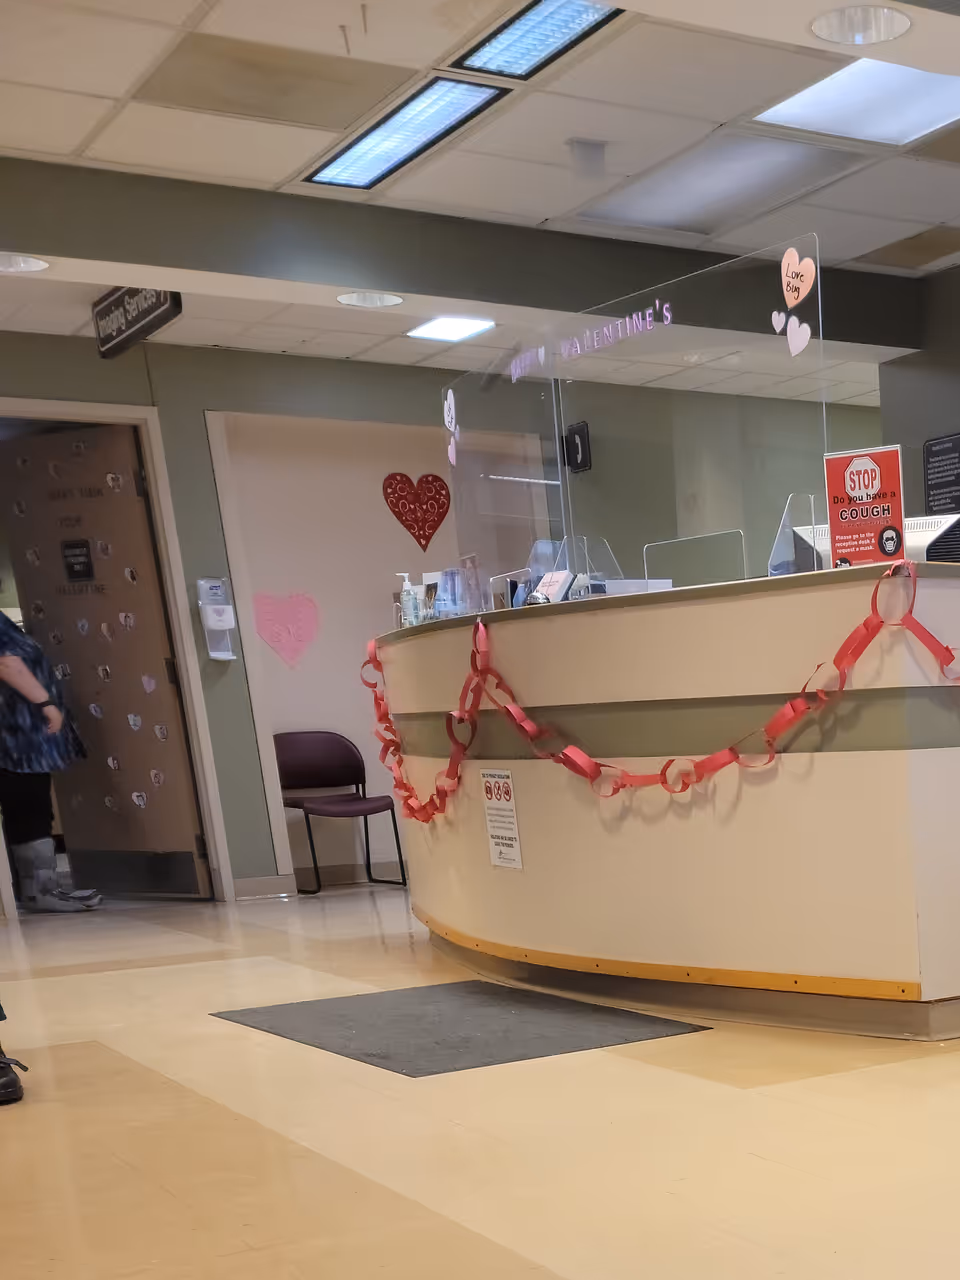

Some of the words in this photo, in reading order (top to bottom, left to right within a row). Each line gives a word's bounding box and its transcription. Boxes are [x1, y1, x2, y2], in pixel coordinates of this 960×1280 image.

[785, 263, 805, 283] Love
[785, 281, 800, 300] Bug
[848, 468, 877, 492] STOP
[833, 495, 845, 505] Do
[847, 495, 864, 505] you
[866, 491, 888, 501] have
[839, 503, 892, 522] COUGH
